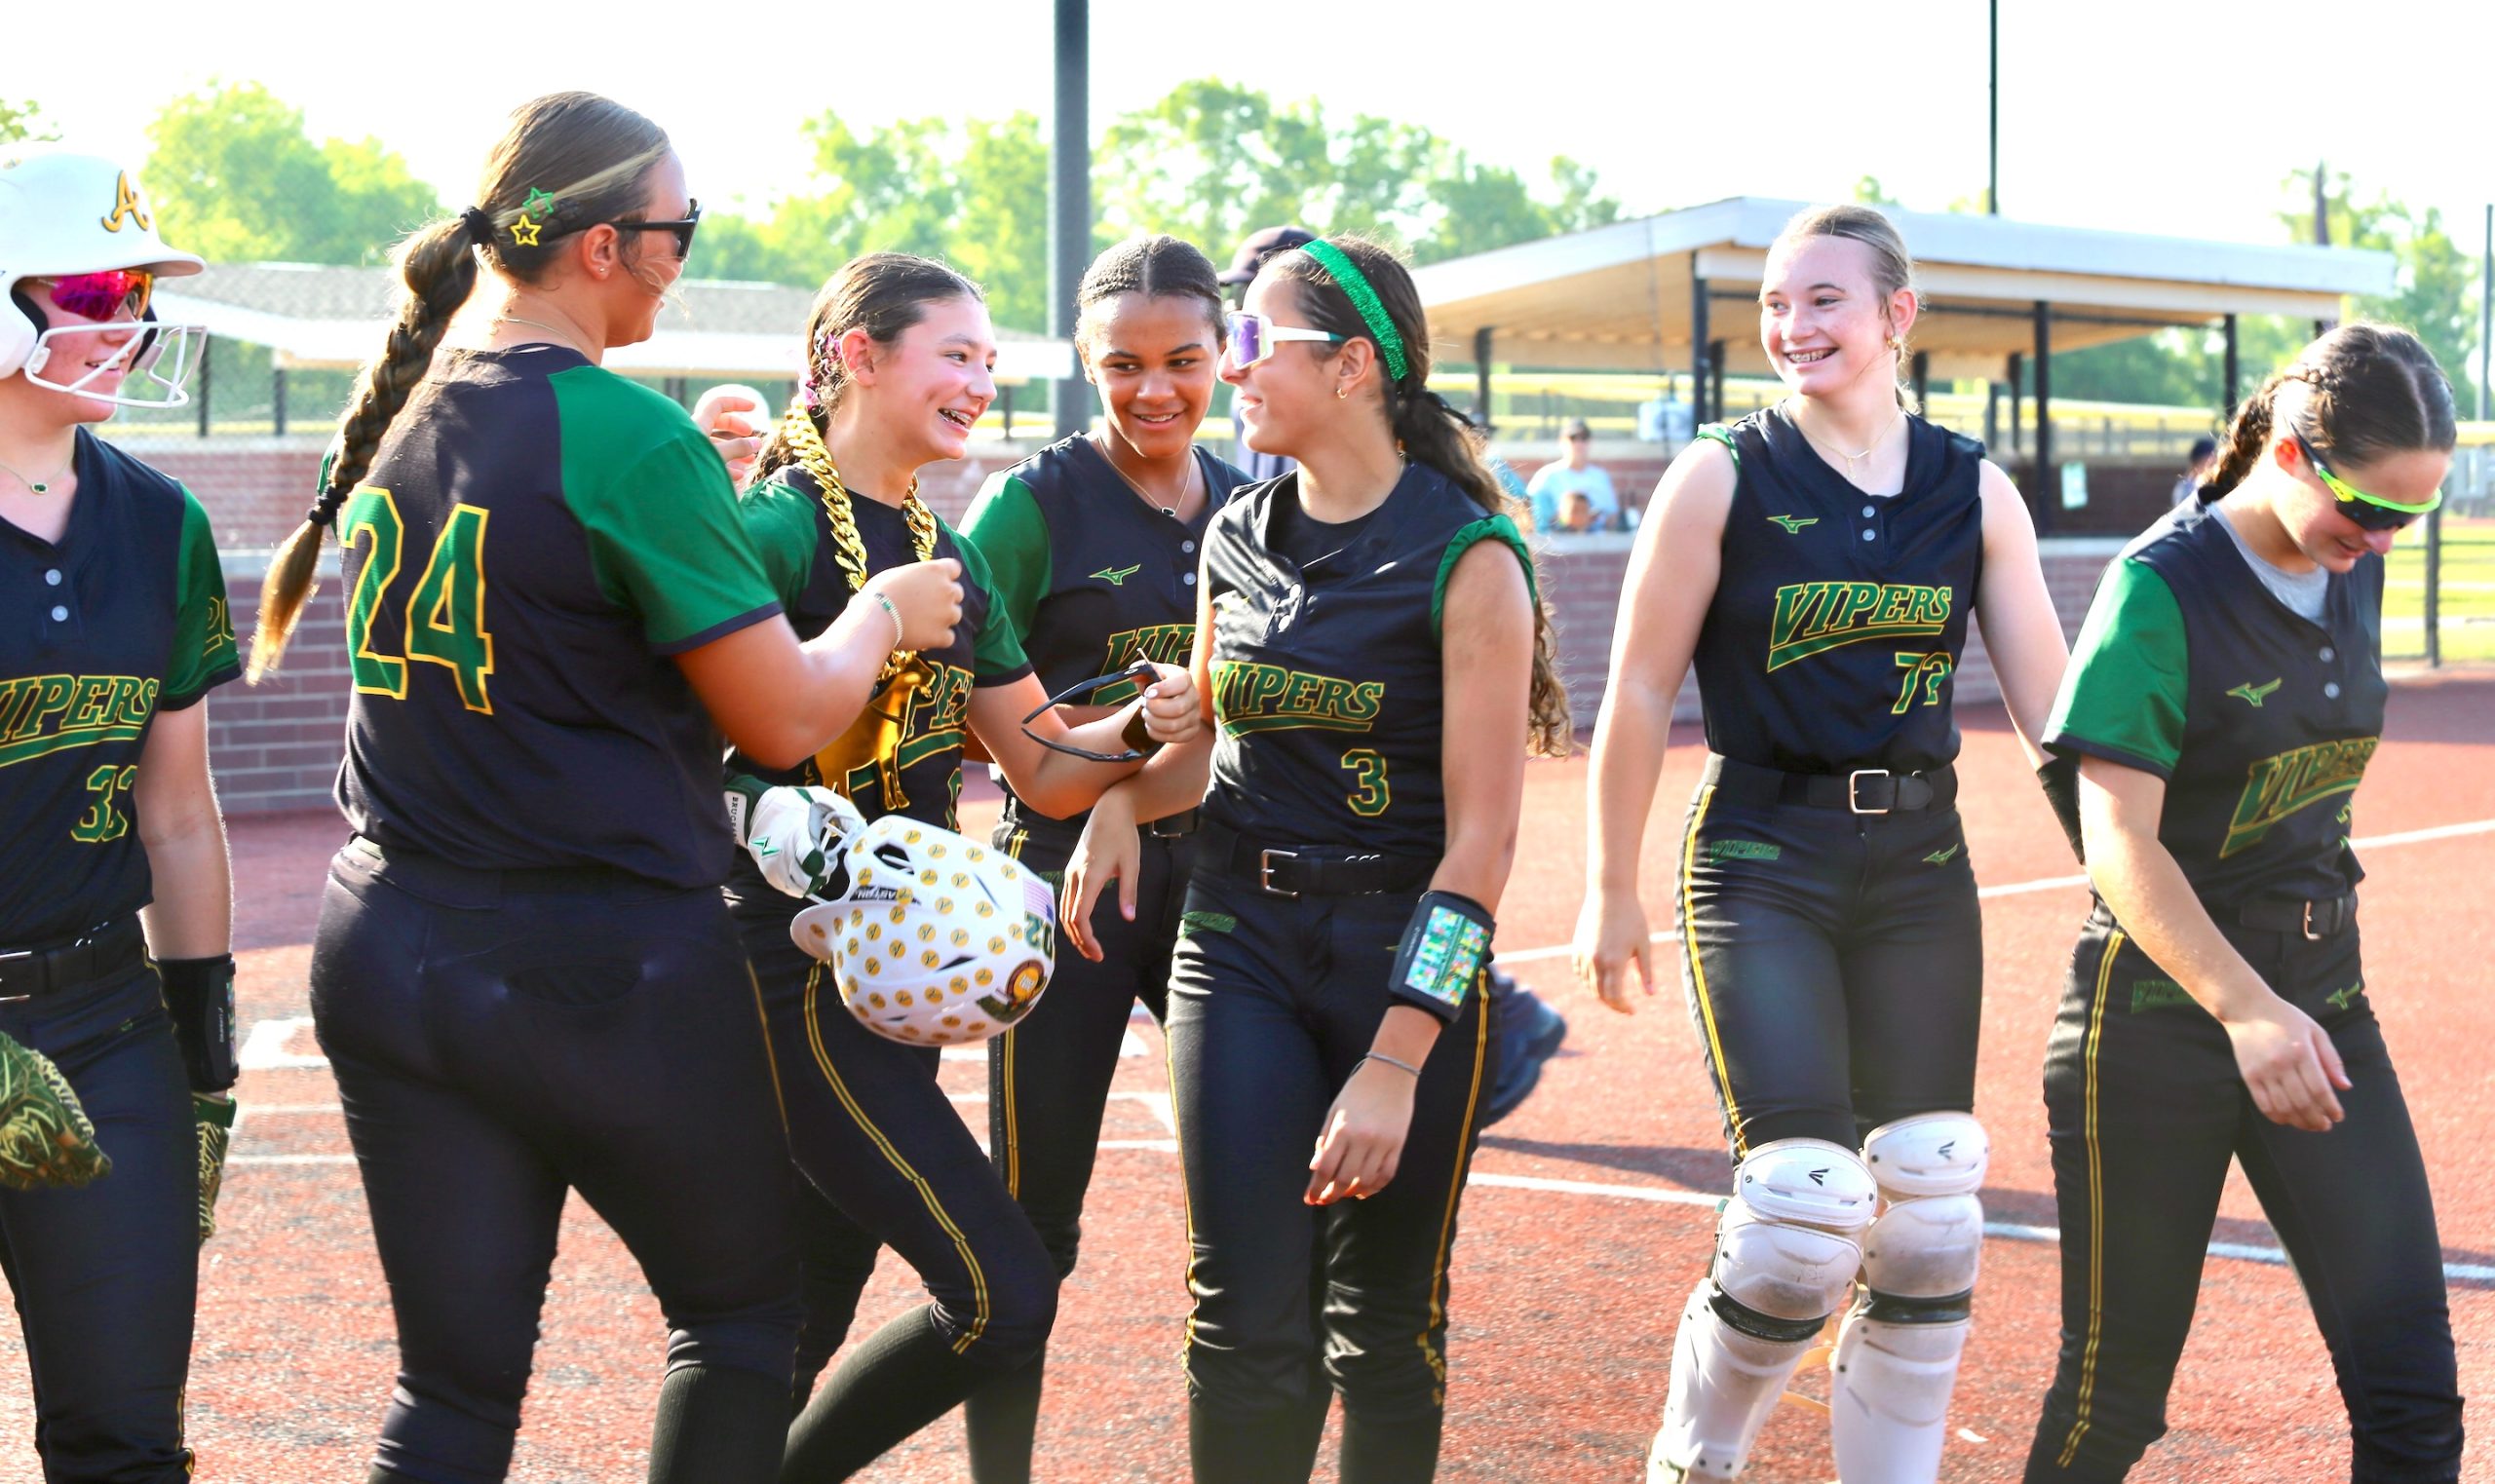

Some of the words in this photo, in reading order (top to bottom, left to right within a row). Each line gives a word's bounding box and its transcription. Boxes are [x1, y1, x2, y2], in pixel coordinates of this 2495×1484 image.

[101, 170, 149, 233] A
[341, 485, 494, 715] 24
[1769, 582, 1952, 649] VIPERS
[1341, 748, 1391, 817] 3
